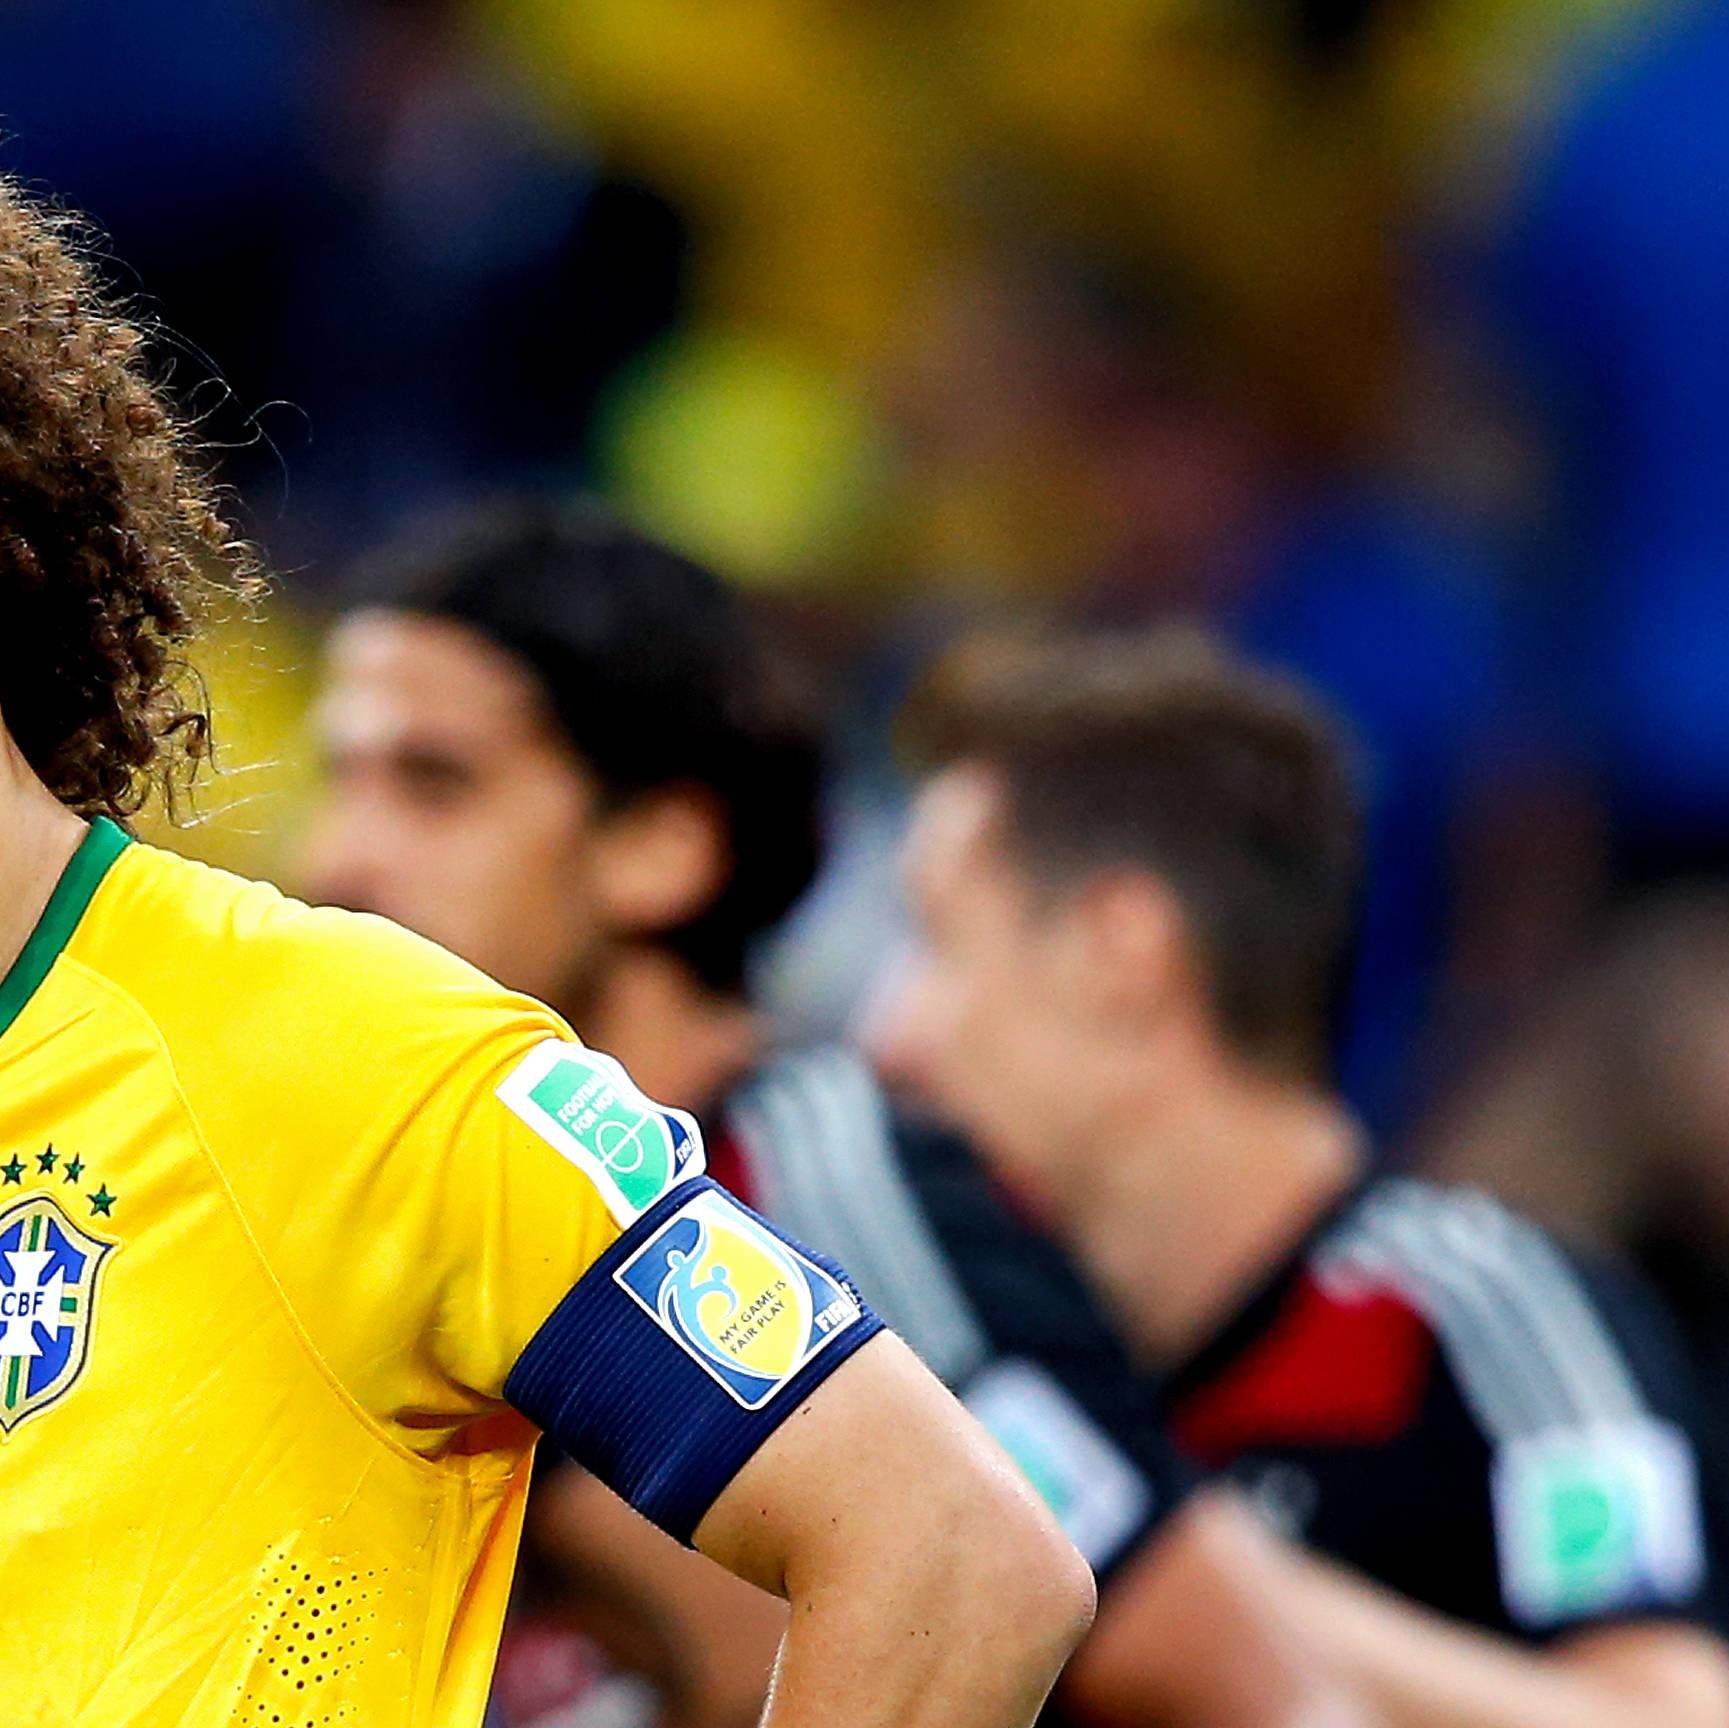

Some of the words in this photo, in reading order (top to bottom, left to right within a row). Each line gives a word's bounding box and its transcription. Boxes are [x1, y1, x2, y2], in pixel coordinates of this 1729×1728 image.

[0, 1291, 45, 1317] CBF
[719, 1323, 739, 1344] MY
[740, 1288, 776, 1322] GAME
[774, 1280, 786, 1291] IS
[730, 1327, 758, 1354] FAIR
[757, 1299, 784, 1328] PLAY
